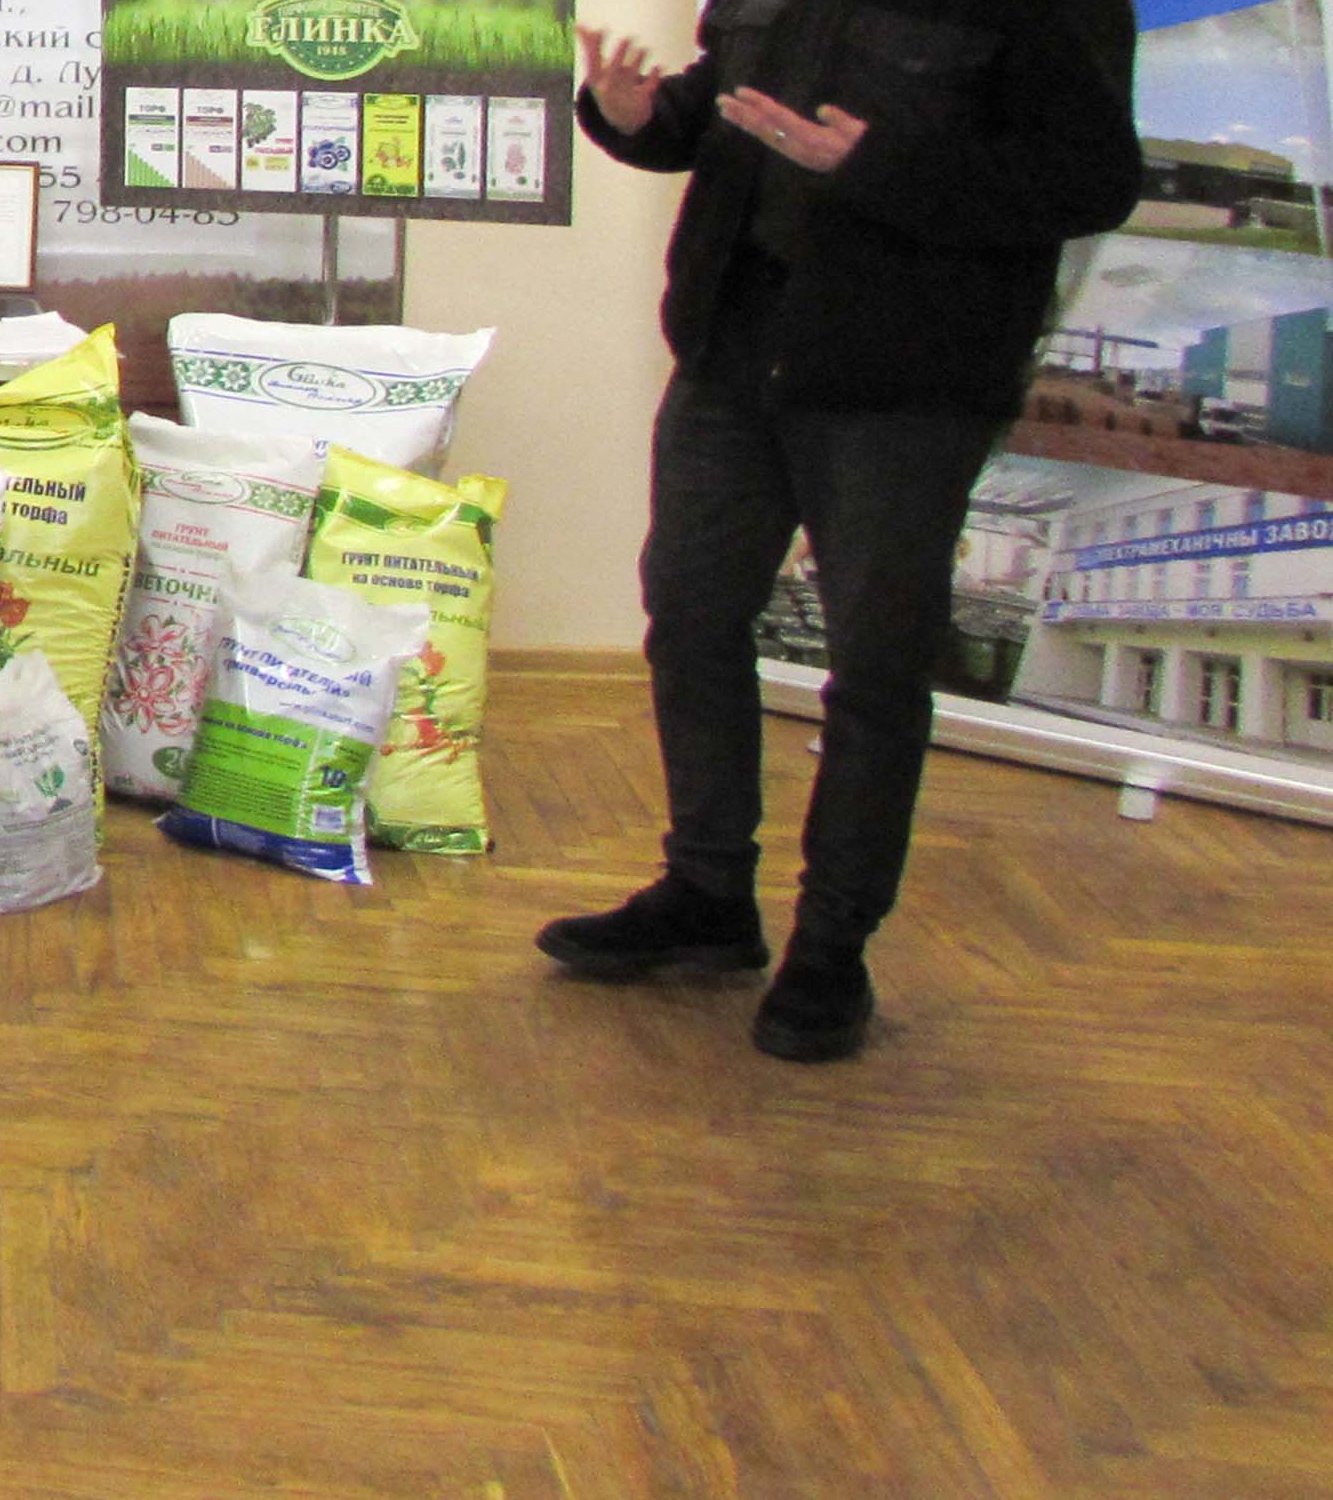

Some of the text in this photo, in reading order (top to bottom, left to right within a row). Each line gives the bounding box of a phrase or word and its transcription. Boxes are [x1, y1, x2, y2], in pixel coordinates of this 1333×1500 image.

[252, 16, 411, 44] ГЛИНКА
[10, 63, 43, 85] д.
[11, 502, 68, 525] торфа
[342, 552, 479, 581] ГРУНТ ПИТАТЕЛЬНЫЙ
[372, 575, 423, 590] основе
[1234, 603, 1318, 619] СУДЬБА
